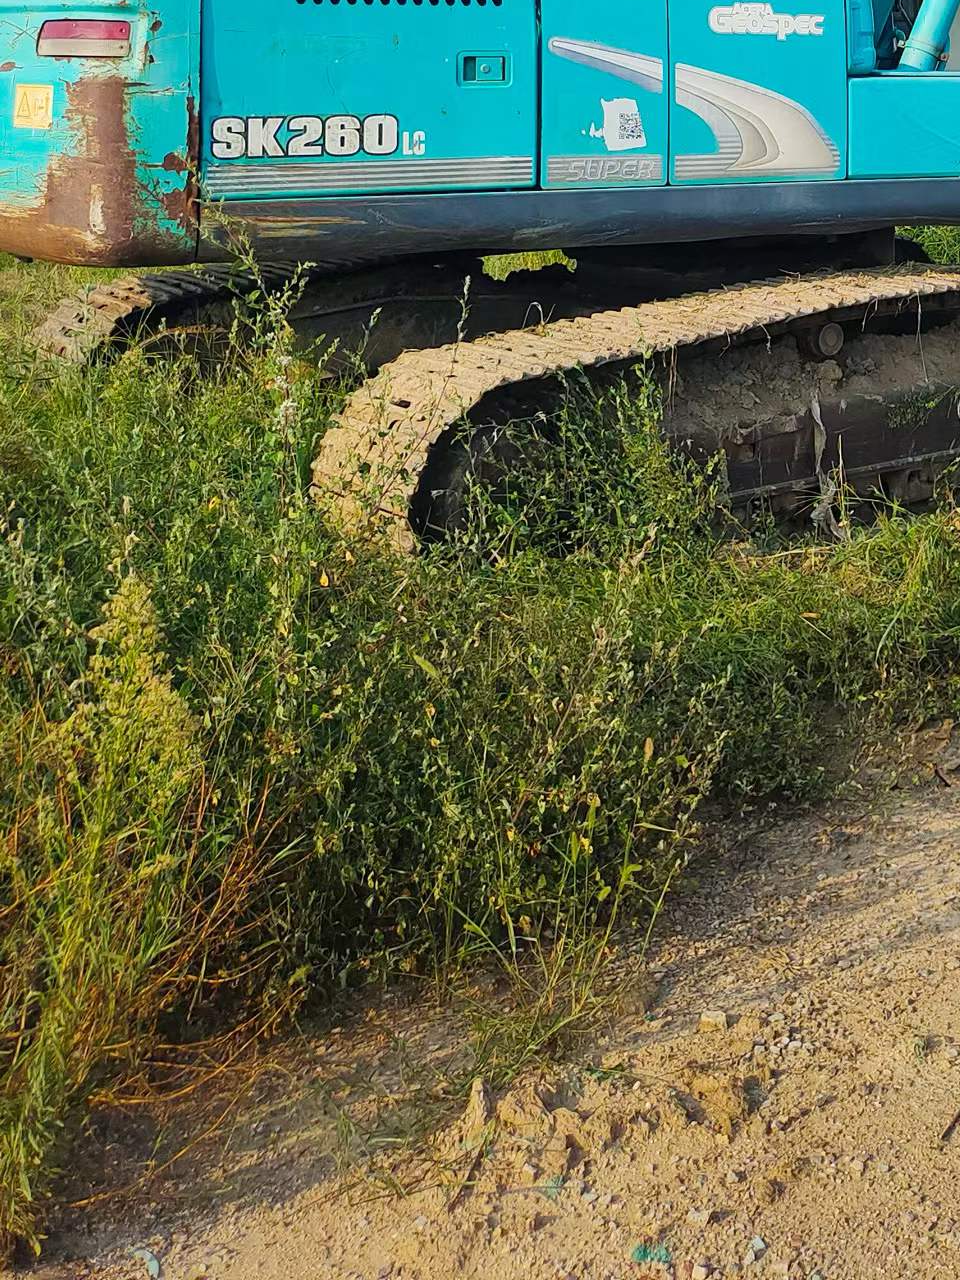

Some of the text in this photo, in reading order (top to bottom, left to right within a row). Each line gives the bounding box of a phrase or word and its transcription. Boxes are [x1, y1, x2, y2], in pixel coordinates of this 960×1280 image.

[211, 114, 426, 159] SK260 LC
[566, 159, 655, 181] SUPER
